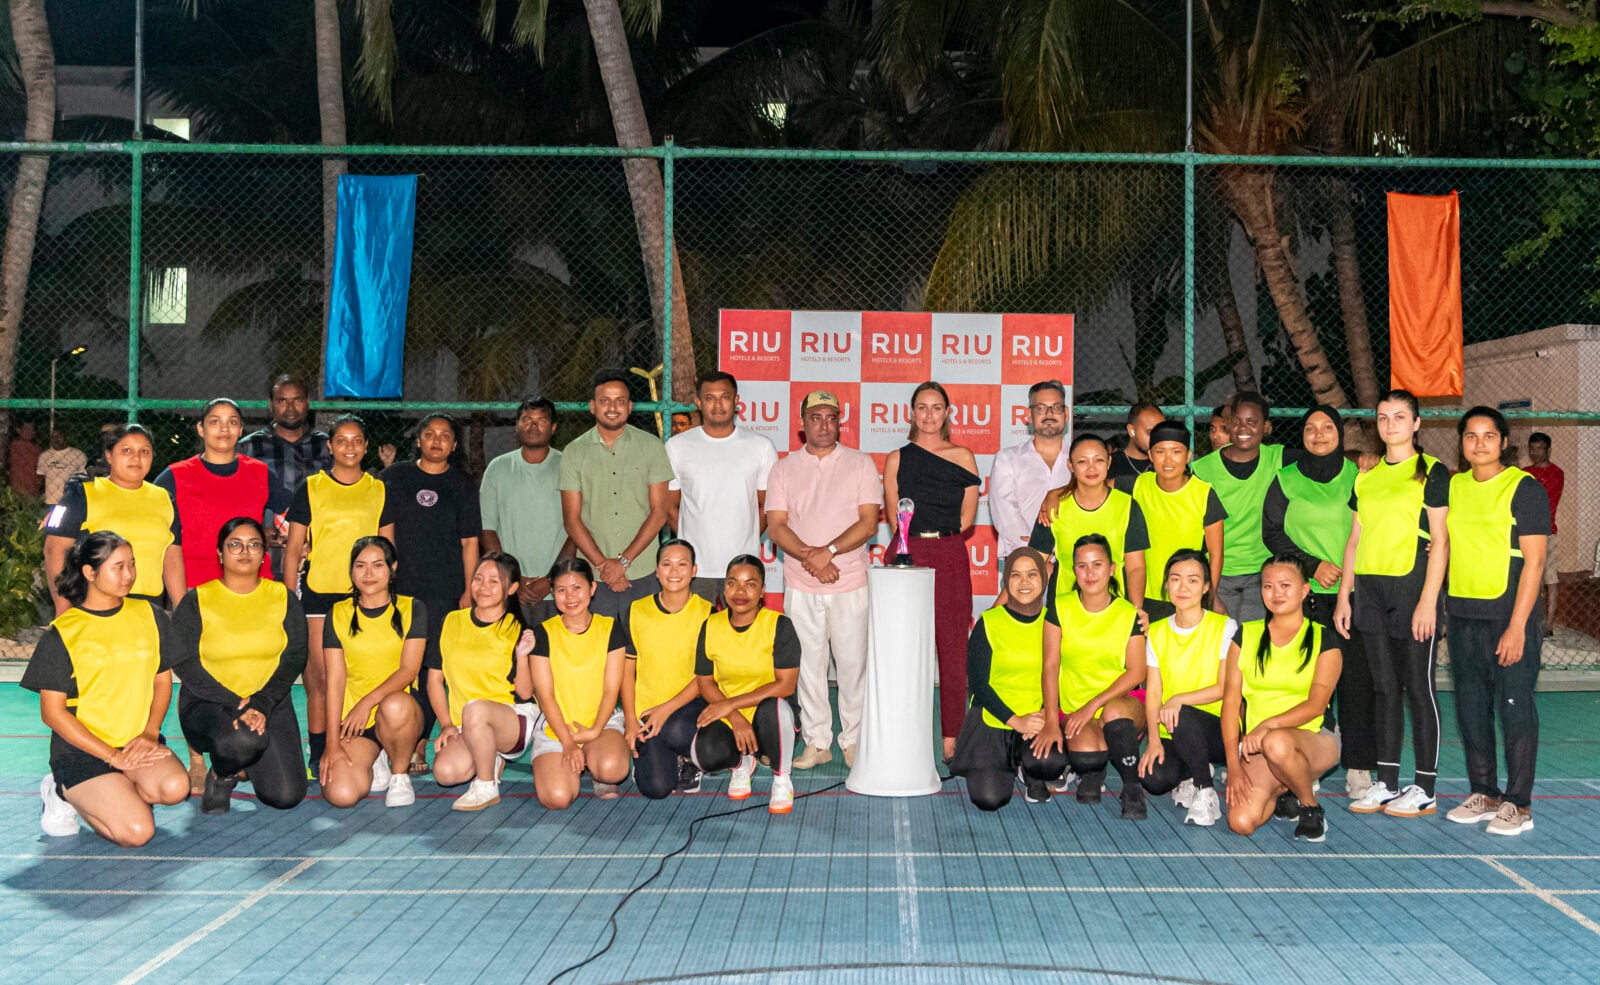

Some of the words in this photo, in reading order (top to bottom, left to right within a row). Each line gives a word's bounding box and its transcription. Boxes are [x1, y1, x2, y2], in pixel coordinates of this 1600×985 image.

[730, 332, 780, 352] RIU
[801, 332, 851, 354] RIU
[872, 333, 922, 354] RIU
[942, 334, 992, 356] RIU
[1012, 336, 1062, 357] RIU
